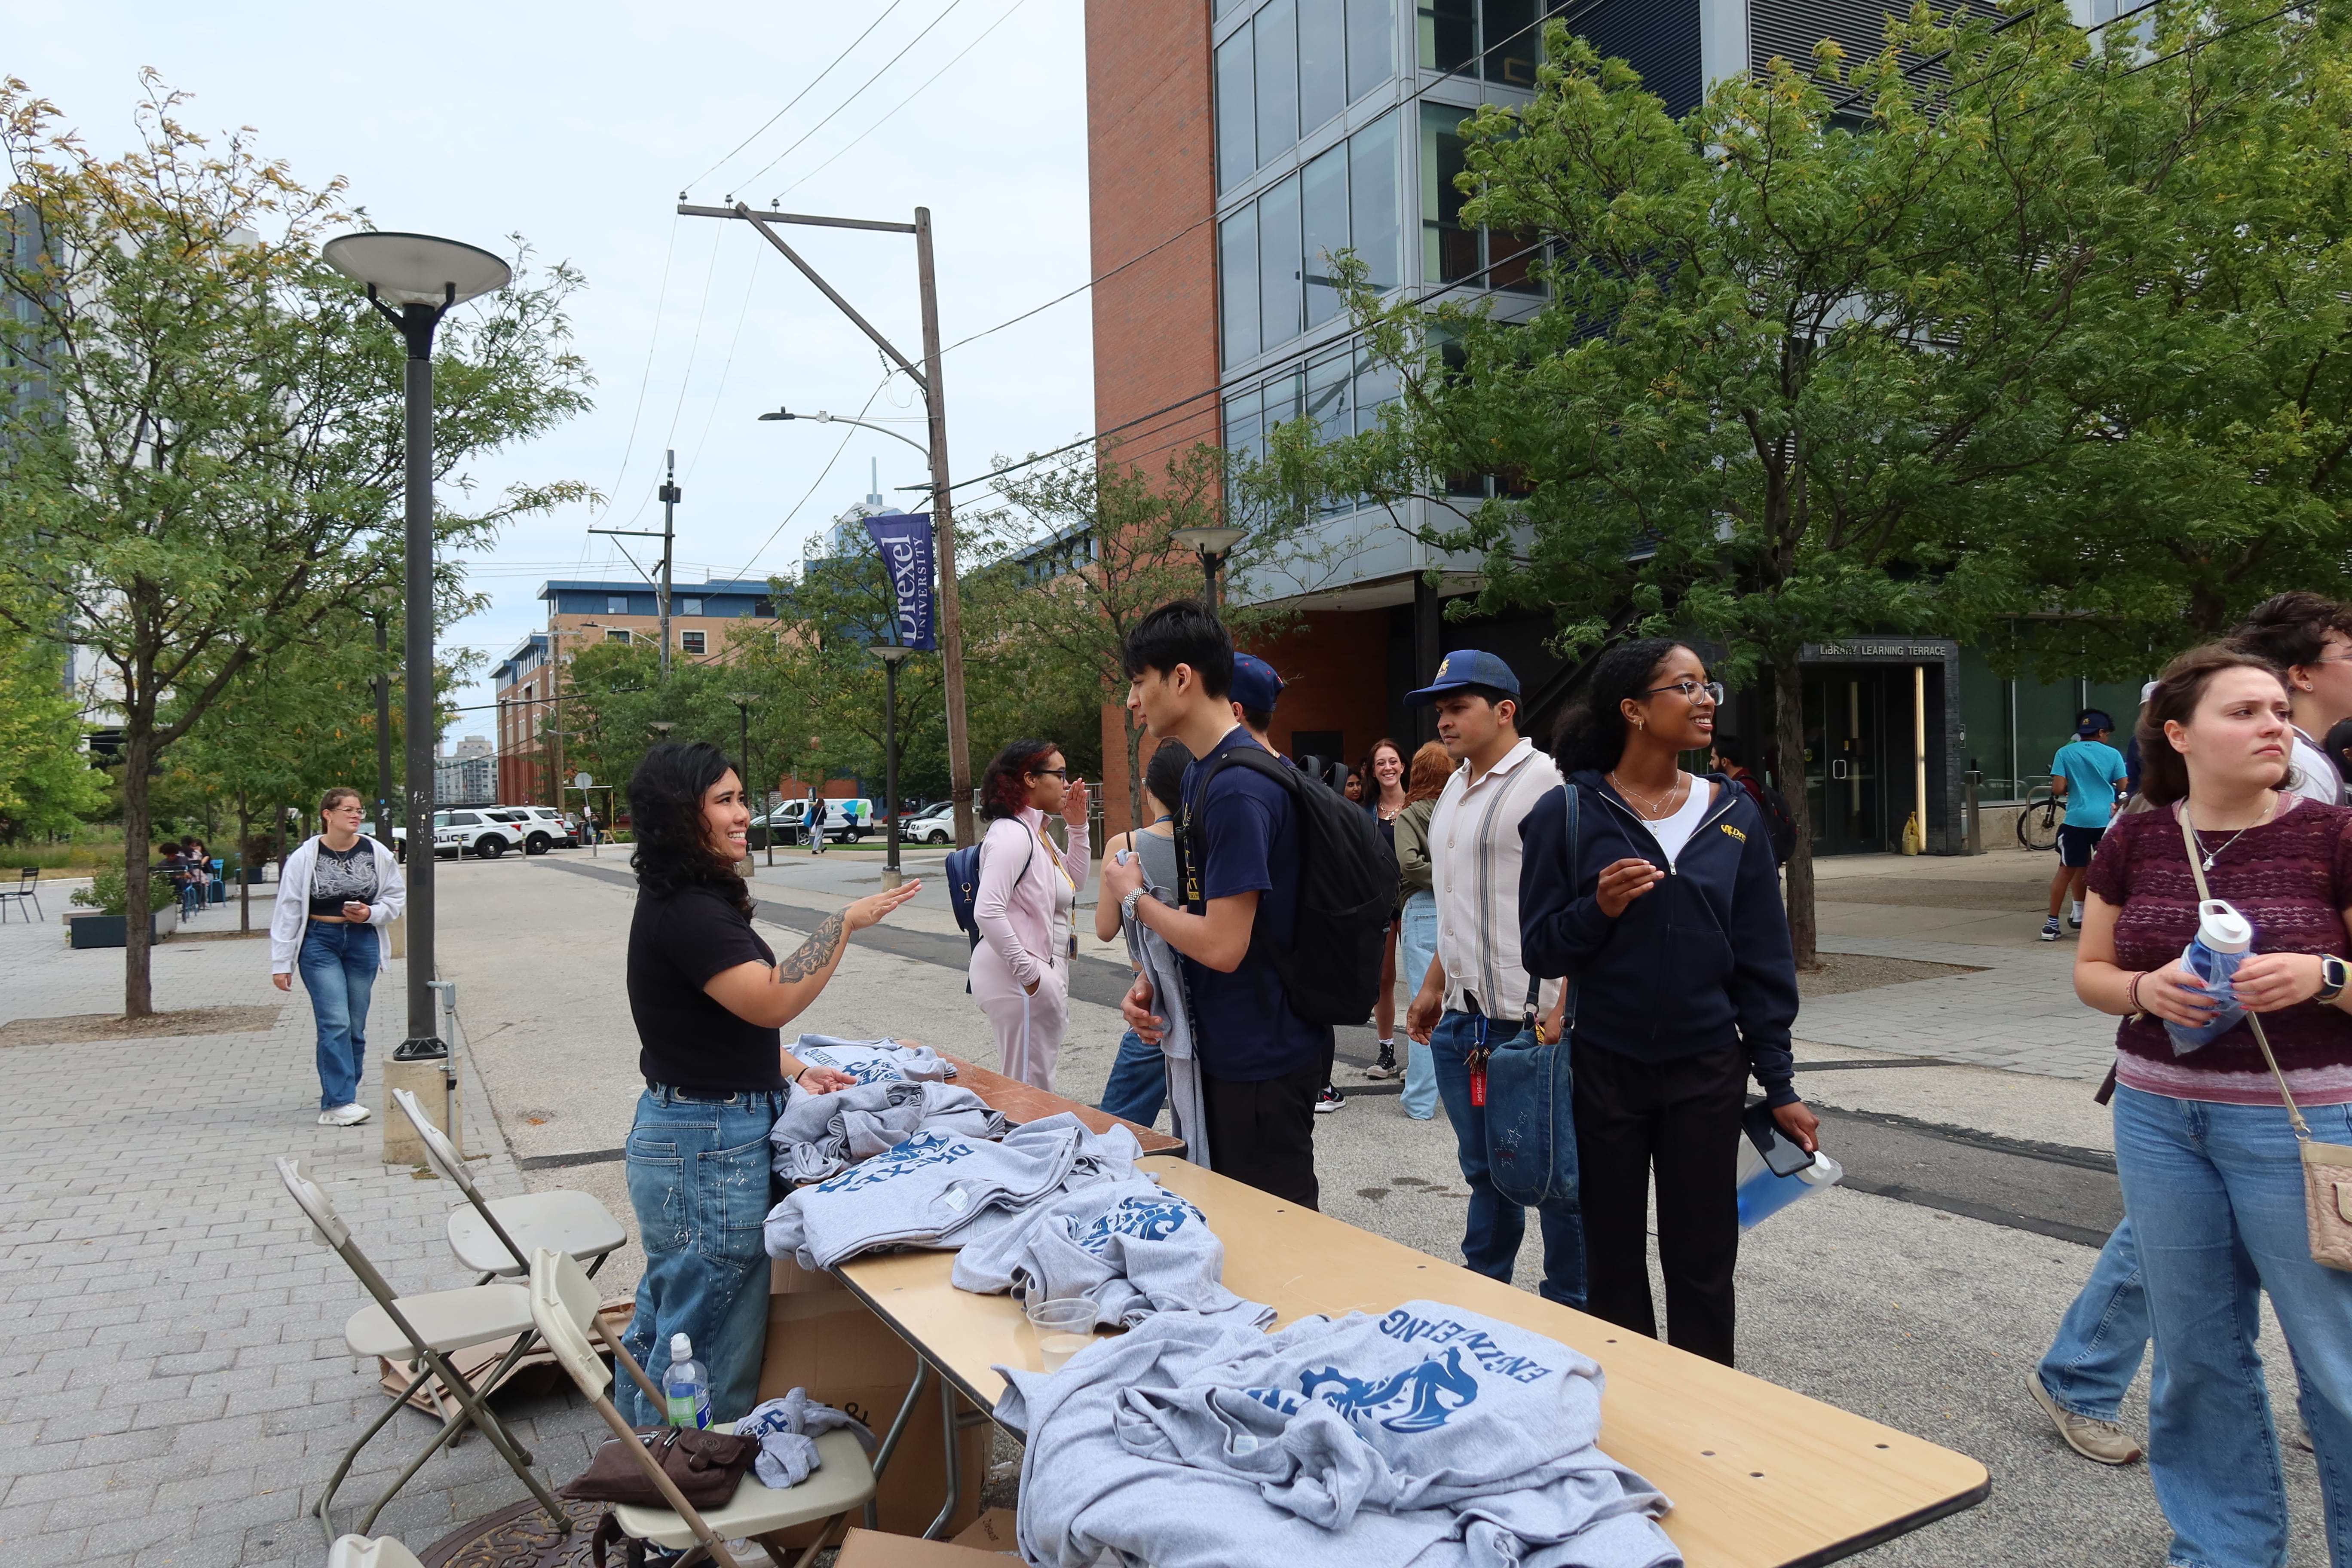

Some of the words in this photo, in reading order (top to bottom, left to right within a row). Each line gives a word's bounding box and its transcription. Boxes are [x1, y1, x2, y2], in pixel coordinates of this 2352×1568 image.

[913, 536, 928, 640] UNIVERSITY
[1862, 646, 1904, 655] LEARNING
[1908, 646, 1946, 656] TERRACE
[433, 834, 469, 843] OLICE
[1732, 827, 1746, 841] Dre
